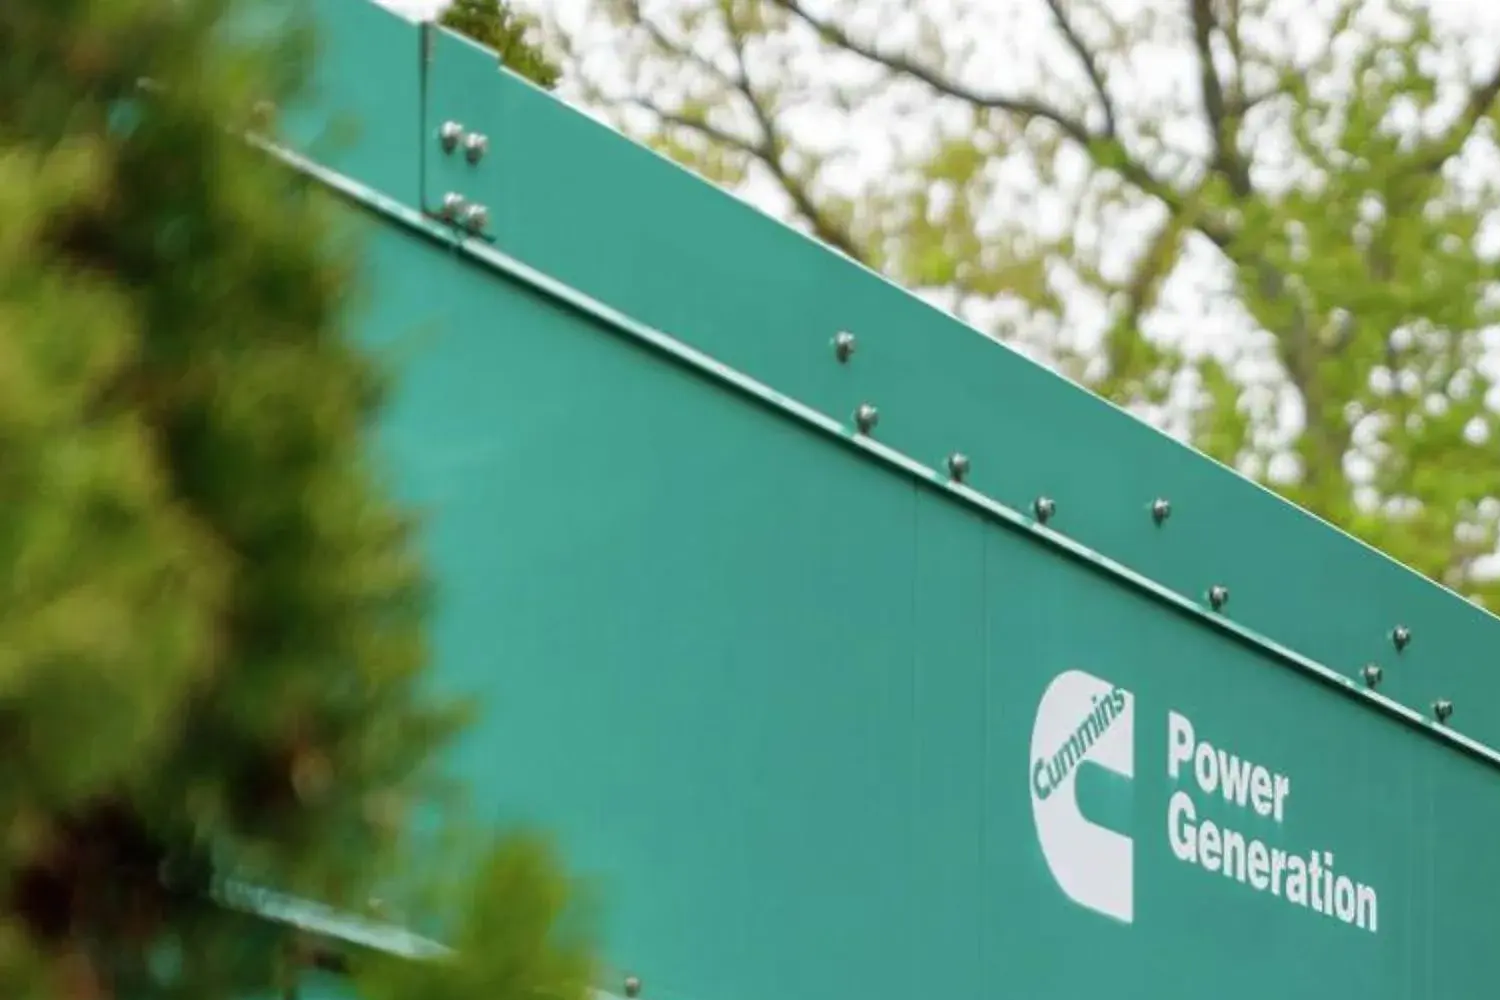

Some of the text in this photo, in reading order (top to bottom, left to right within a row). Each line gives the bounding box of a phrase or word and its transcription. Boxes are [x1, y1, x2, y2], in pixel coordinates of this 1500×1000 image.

[1031, 687, 1126, 800] Cummins
[1168, 709, 1289, 822] Power
[1167, 790, 1377, 932] Generation
